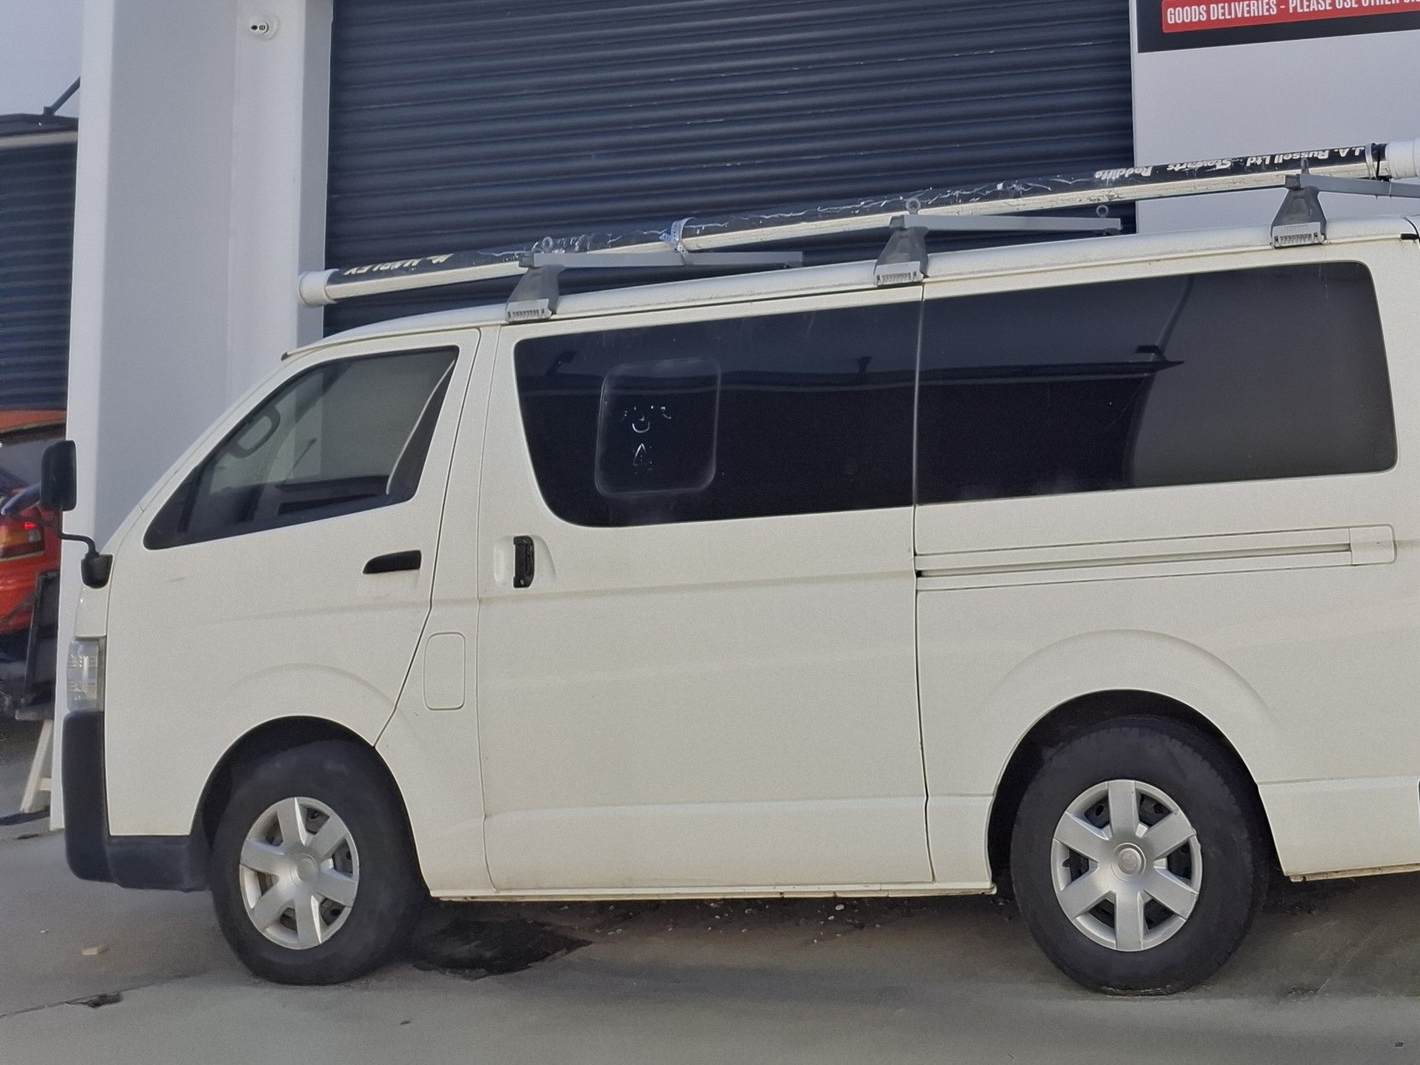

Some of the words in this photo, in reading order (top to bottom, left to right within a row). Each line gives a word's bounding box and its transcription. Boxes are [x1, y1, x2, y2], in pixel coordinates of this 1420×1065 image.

[1167, 4, 1207, 24] GOODS
[1246, 155, 1271, 167] Ltd
[1274, 150, 1330, 164] Russell
